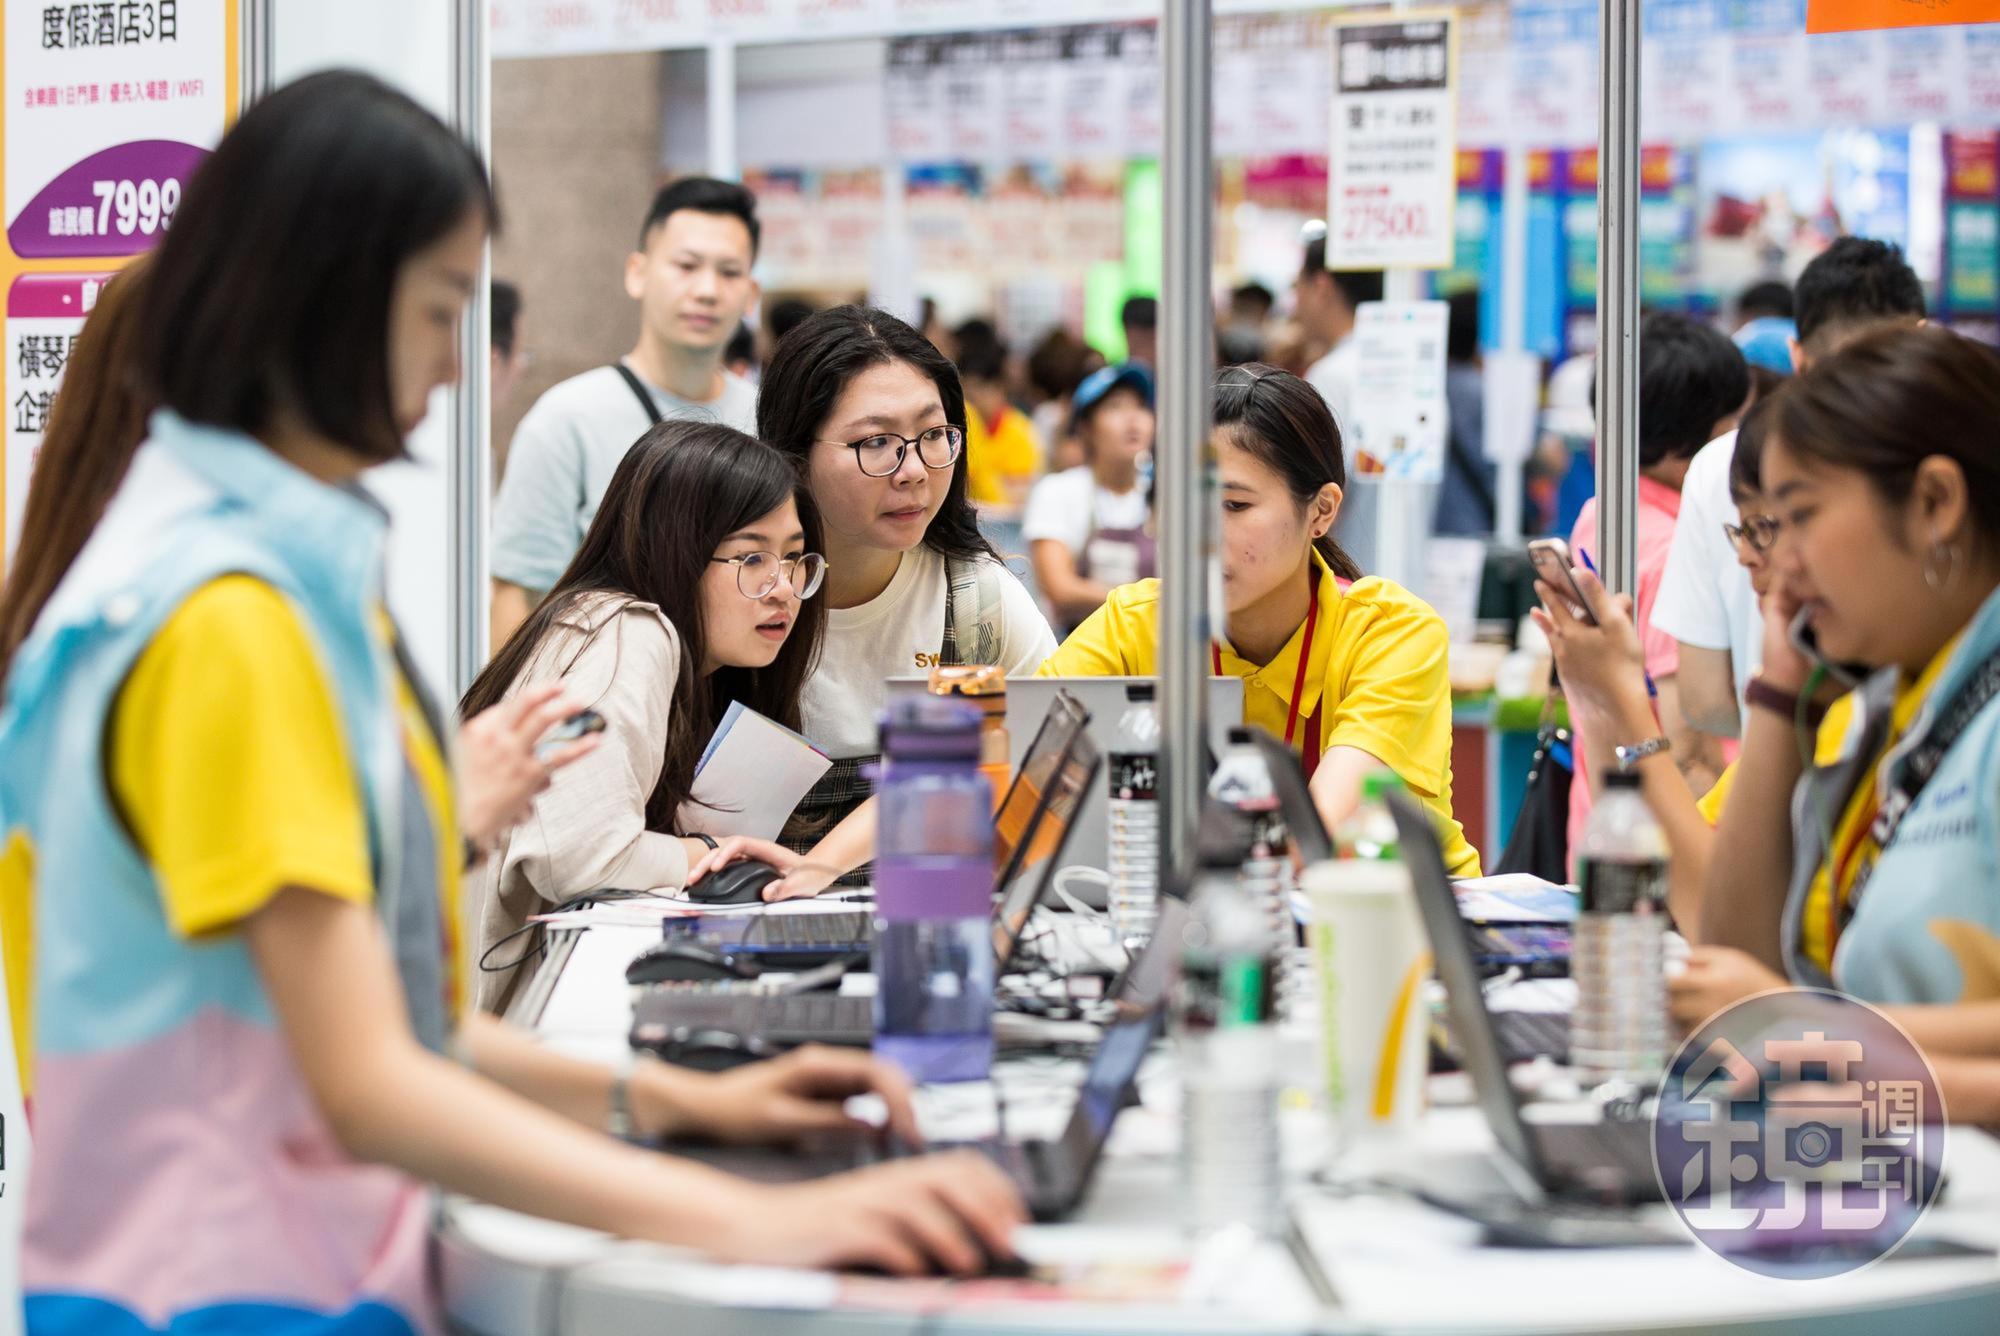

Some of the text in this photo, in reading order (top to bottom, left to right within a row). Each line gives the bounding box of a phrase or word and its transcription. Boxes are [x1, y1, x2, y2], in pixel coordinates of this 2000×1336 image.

[42, 0, 176, 49] 度假酒店3日
[92, 177, 182, 236] 7999
